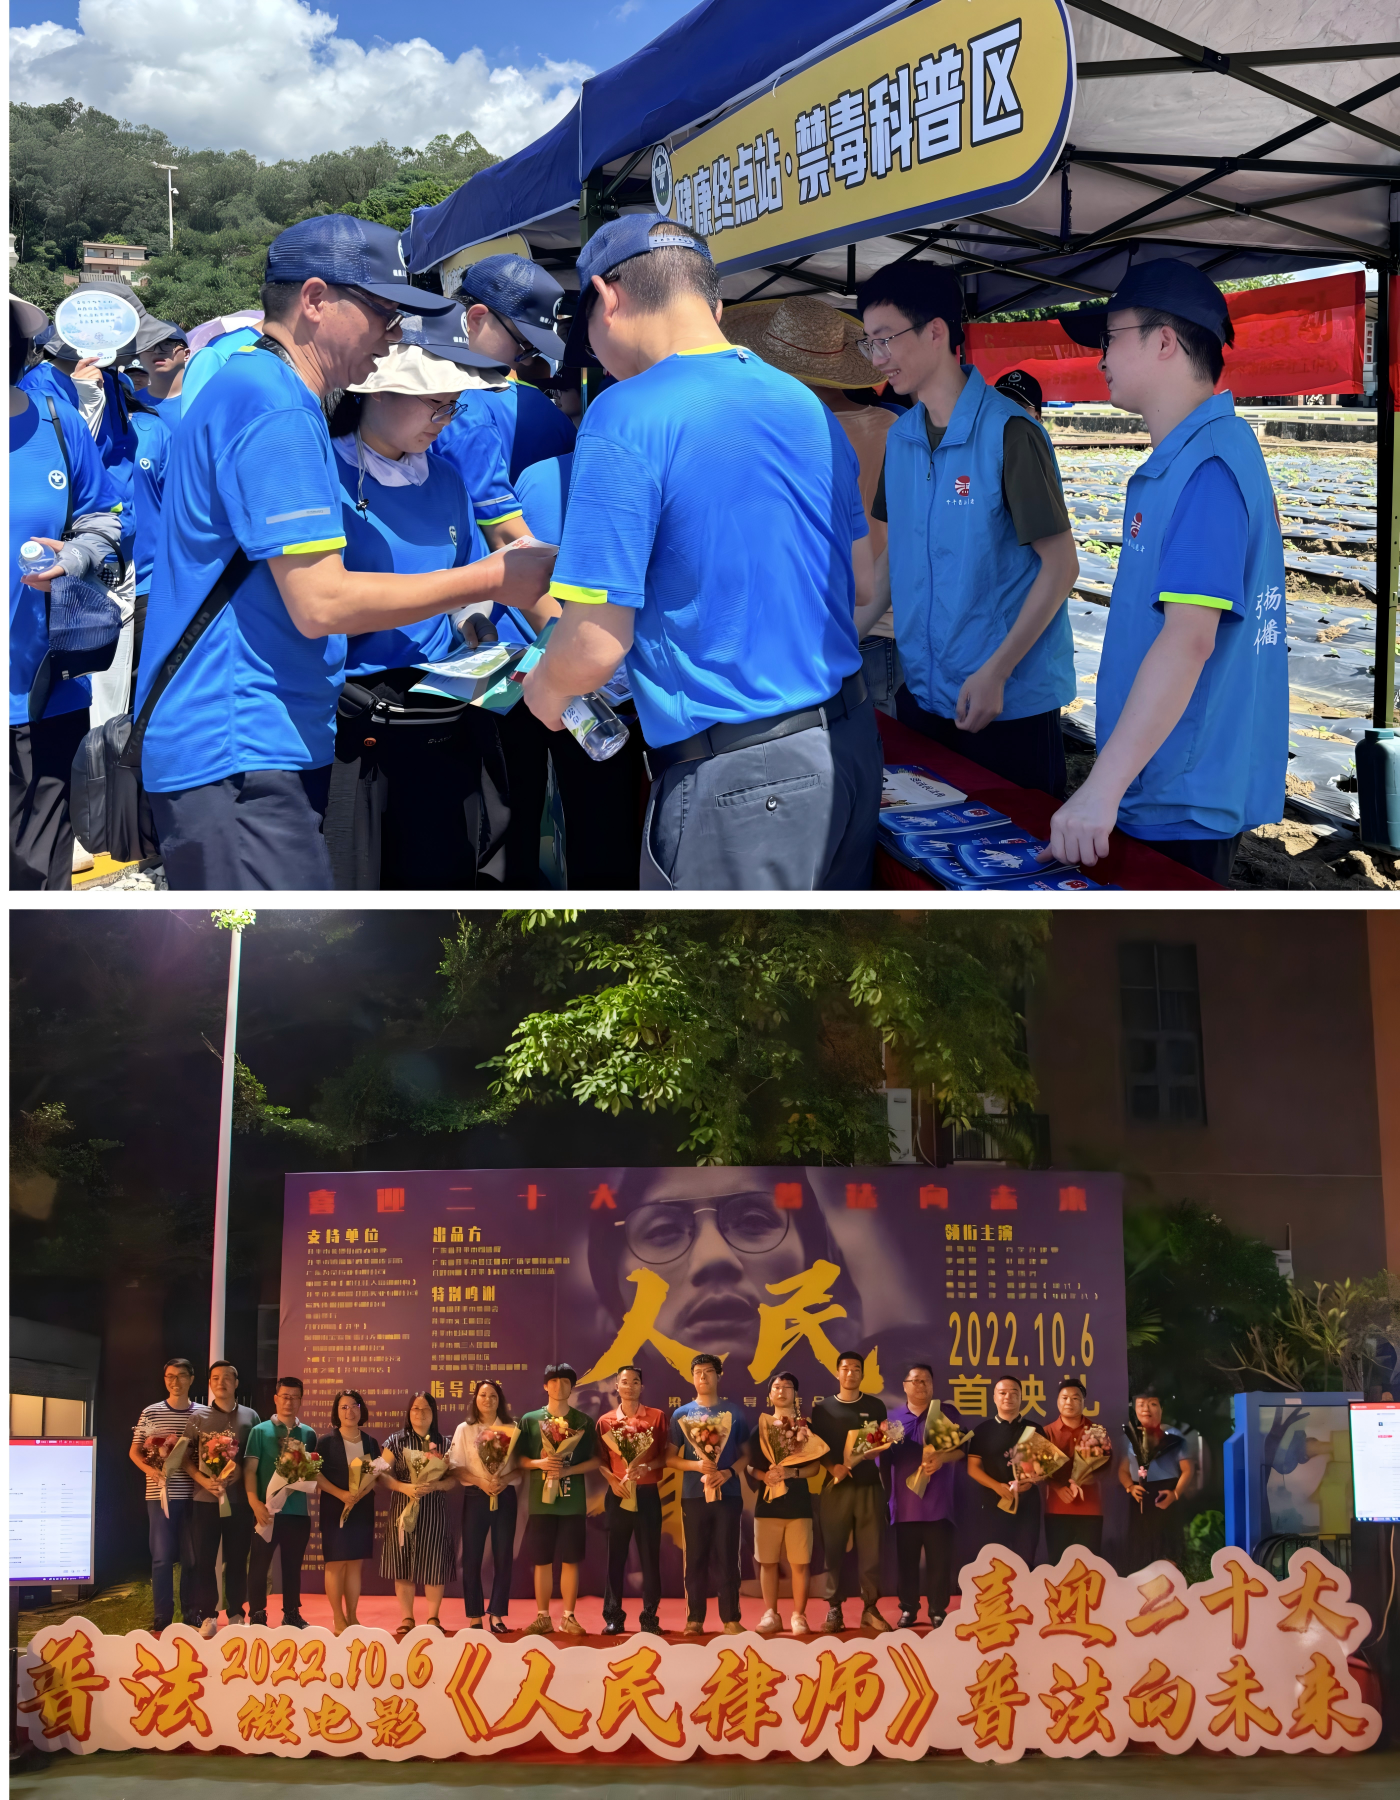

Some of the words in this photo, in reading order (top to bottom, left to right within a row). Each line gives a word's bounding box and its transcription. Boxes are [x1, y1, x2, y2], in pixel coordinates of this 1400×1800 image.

[674, 17, 1024, 236] 健康终点站·禁毒科普区
[432, 1226, 481, 1242] 出品方
[575, 1258, 885, 1395] 人民
[948, 1311, 1094, 1367] 2022.10.6
[955, 1556, 1358, 1654] 喜迎二十大
[21, 1630, 213, 1742] 普法
[220, 1636, 434, 1691] 2022.10.6
[445, 1642, 939, 1751] 《人民律师》
[957, 1652, 1370, 1751] 普法向未来
[237, 1694, 426, 1749] 微电影
